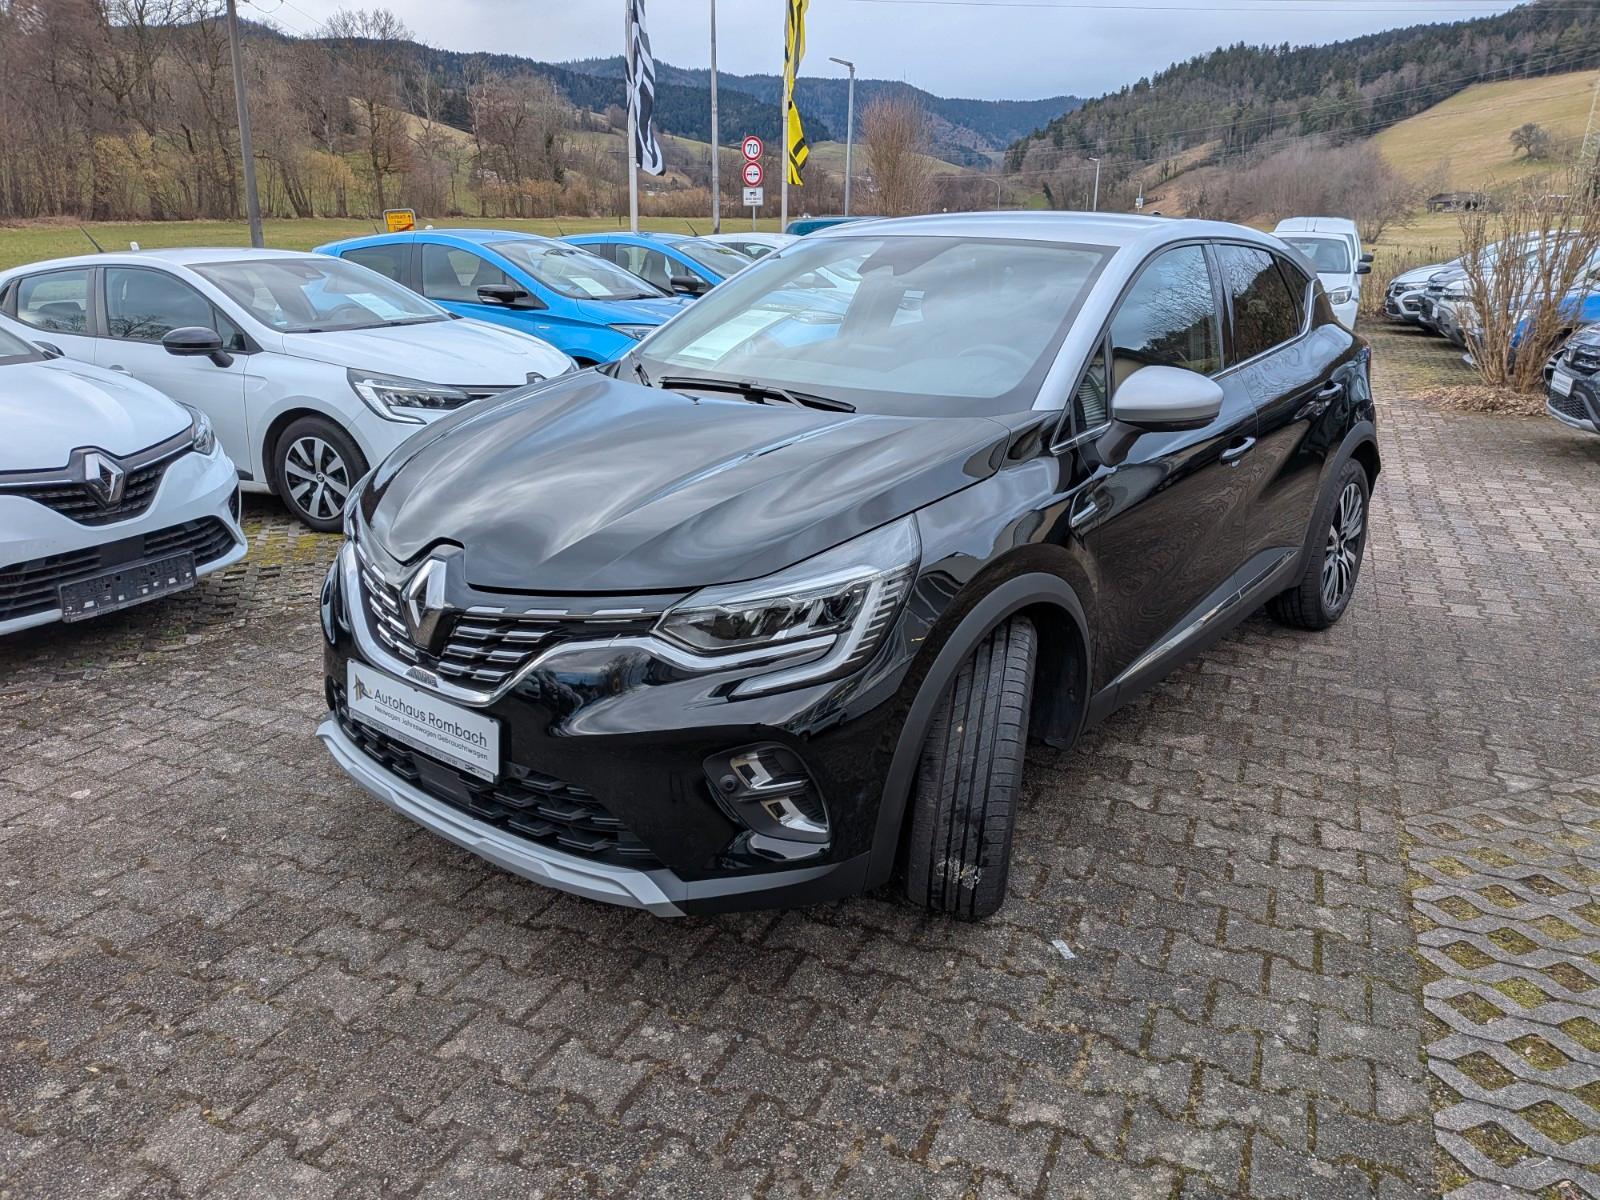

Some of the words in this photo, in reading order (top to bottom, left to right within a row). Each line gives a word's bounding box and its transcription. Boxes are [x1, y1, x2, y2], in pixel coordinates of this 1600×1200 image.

[747, 143, 759, 155] 70
[374, 689, 426, 722] Autohaus
[428, 712, 487, 747] Rombach
[374, 705, 401, 722] Neuwagen
[401, 717, 437, 739] Jahreswagen
